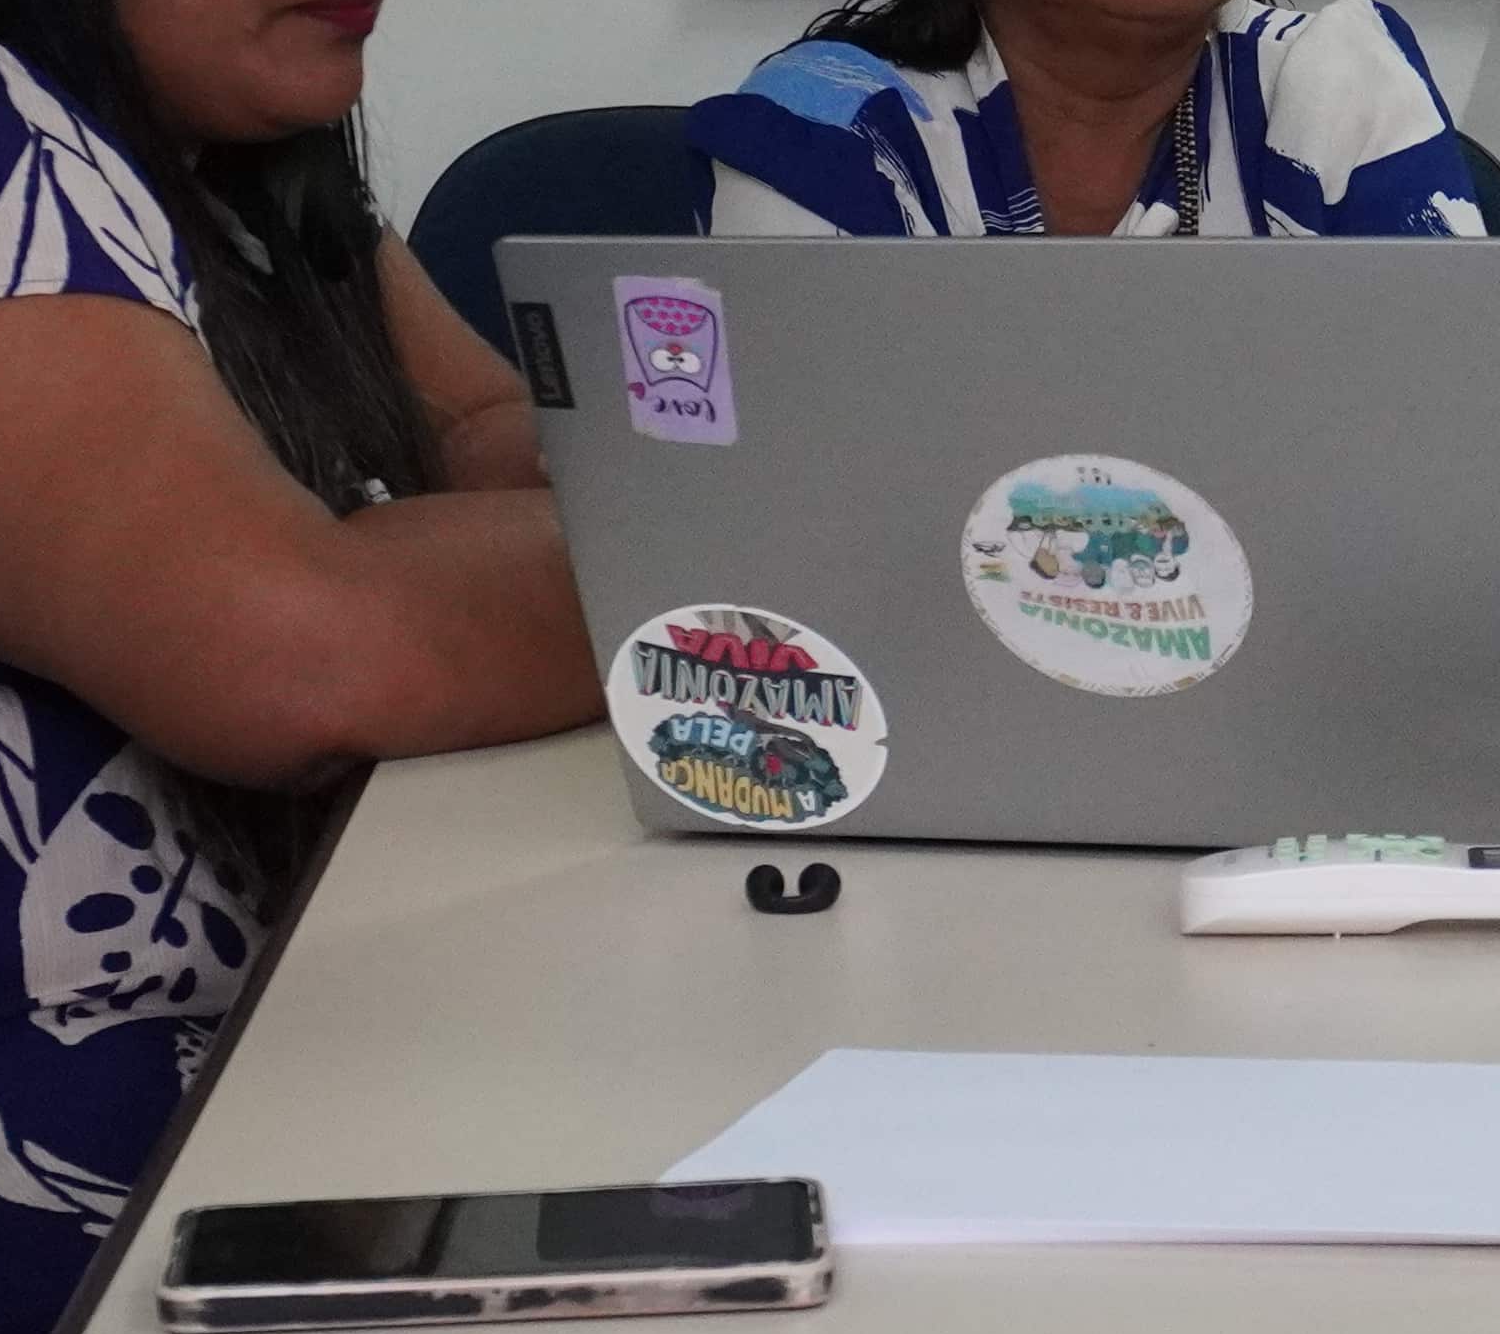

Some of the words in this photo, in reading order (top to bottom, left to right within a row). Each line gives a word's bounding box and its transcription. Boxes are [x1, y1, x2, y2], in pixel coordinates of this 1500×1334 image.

[1145, 592, 1205, 624] VIVE
[664, 624, 820, 674] VIVA
[670, 717, 756, 757] PELA
[659, 756, 794, 820] MUDANÇA
[795, 789, 818, 813] A
